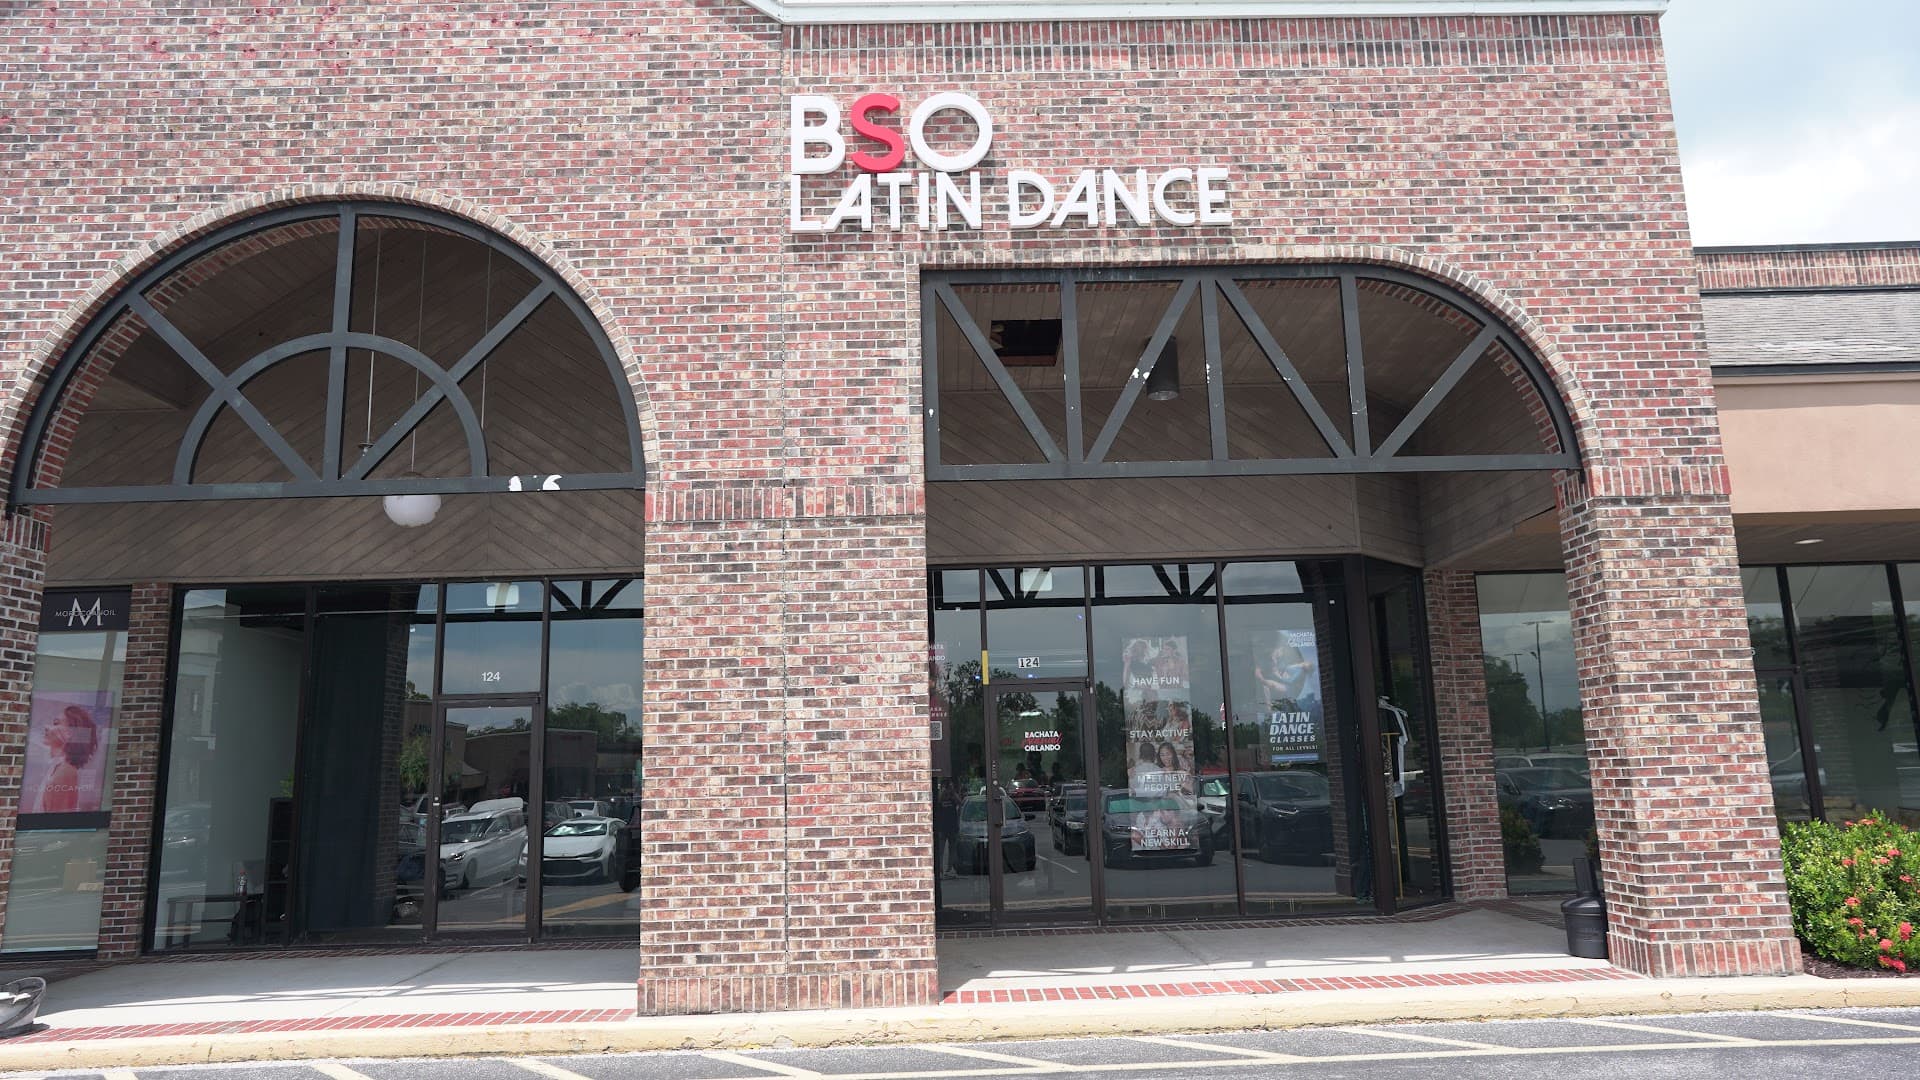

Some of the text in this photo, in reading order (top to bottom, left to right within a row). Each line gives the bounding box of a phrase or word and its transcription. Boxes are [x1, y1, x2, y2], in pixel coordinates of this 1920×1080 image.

[790, 92, 993, 174] BSO
[790, 167, 1233, 232] LATIN DANCE
[1020, 658, 1039, 667] 124
[481, 671, 500, 682] 124
[1133, 676, 1180, 686] HAVE FUN
[1271, 712, 1311, 724] LATIN
[1130, 729, 1189, 738] STAY ACTIVE
[1269, 723, 1315, 735] DANCE
[1024, 730, 1059, 738] BACHATA
[1270, 735, 1316, 744] CLASSES
[1024, 744, 1061, 752] ORLANDO
[1137, 774, 1186, 783] MEET NEW
[26, 784, 96, 793] MOOCCANOIL
[1144, 783, 1181, 792] PEOPLE
[1146, 829, 1185, 838] LEARN A
[1141, 838, 1191, 848] NEW SKILL
